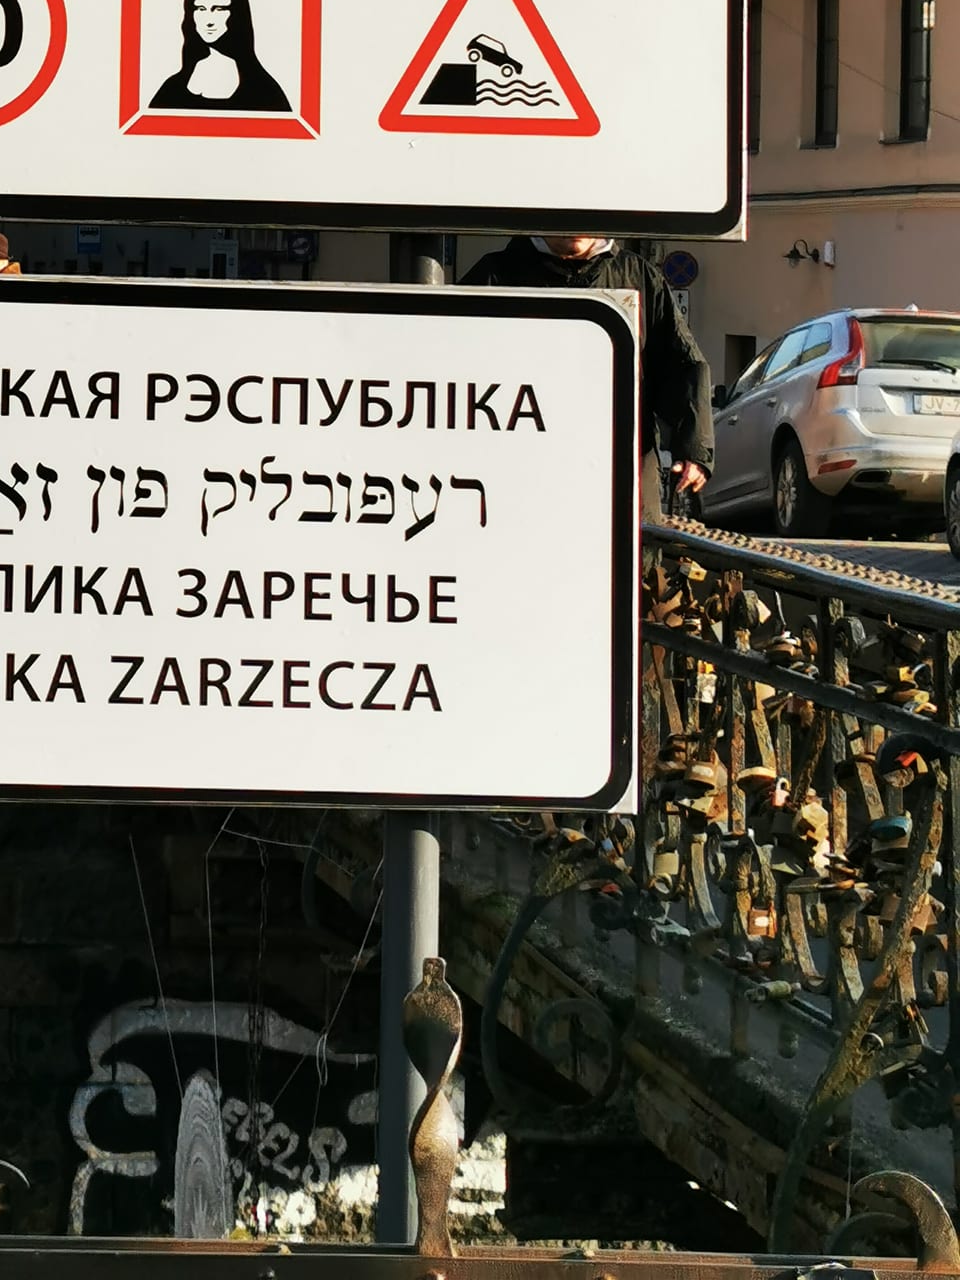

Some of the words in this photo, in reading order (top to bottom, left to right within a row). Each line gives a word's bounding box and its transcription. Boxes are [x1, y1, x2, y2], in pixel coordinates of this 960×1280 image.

[146, 372, 546, 432] РЭСПУБЛІКА
[87, 465, 168, 533] פון
[176, 569, 458, 624] ЗАРЕЧЬЕ
[109, 656, 443, 711] ZARZECZA
